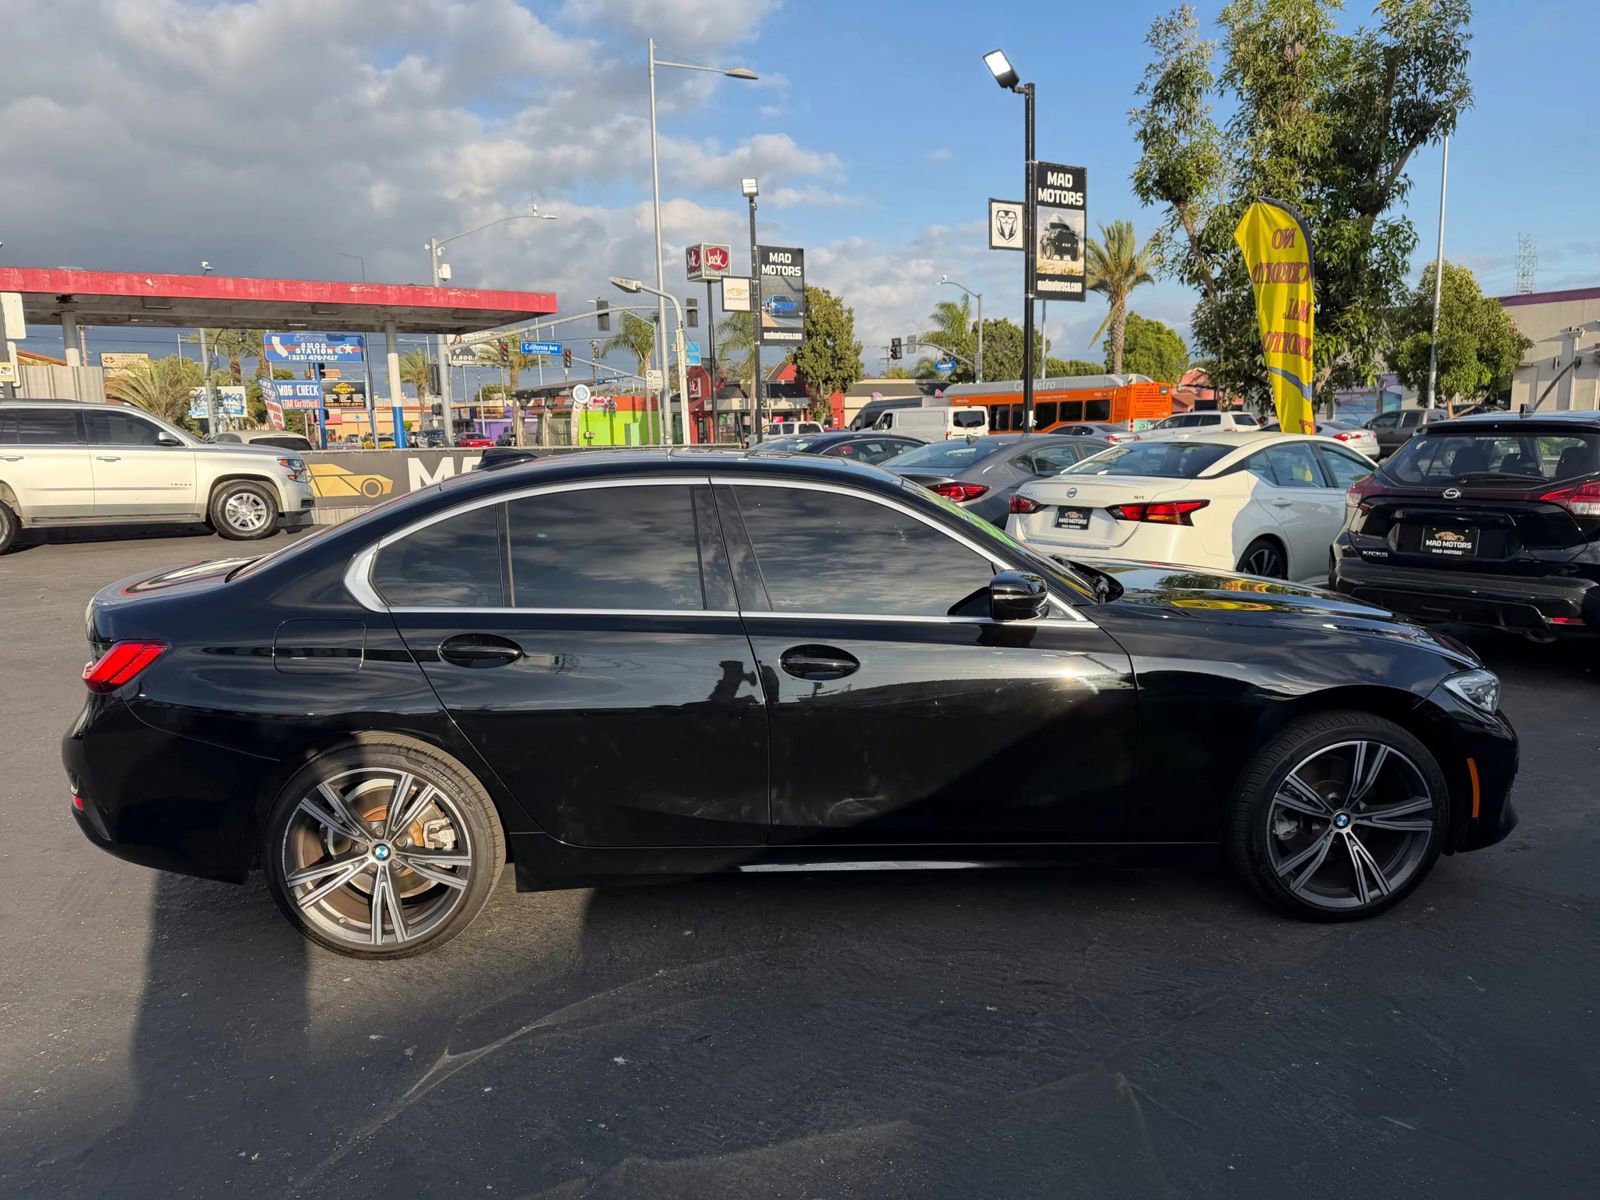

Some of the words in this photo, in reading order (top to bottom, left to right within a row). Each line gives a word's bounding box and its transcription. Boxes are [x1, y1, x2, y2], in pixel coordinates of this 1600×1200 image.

[1047, 171, 1073, 188] MAD
[1038, 187, 1084, 206] MOTORS
[706, 249, 728, 268] Jack
[769, 252, 791, 263] MAD
[761, 264, 802, 276] MOTORS
[525, 343, 549, 351] California
[277, 385, 293, 396] MOG
[297, 384, 320, 396] CHECK
[1442, 541, 1473, 549] MOTORS
[422, 763, 460, 792] Cinturato
